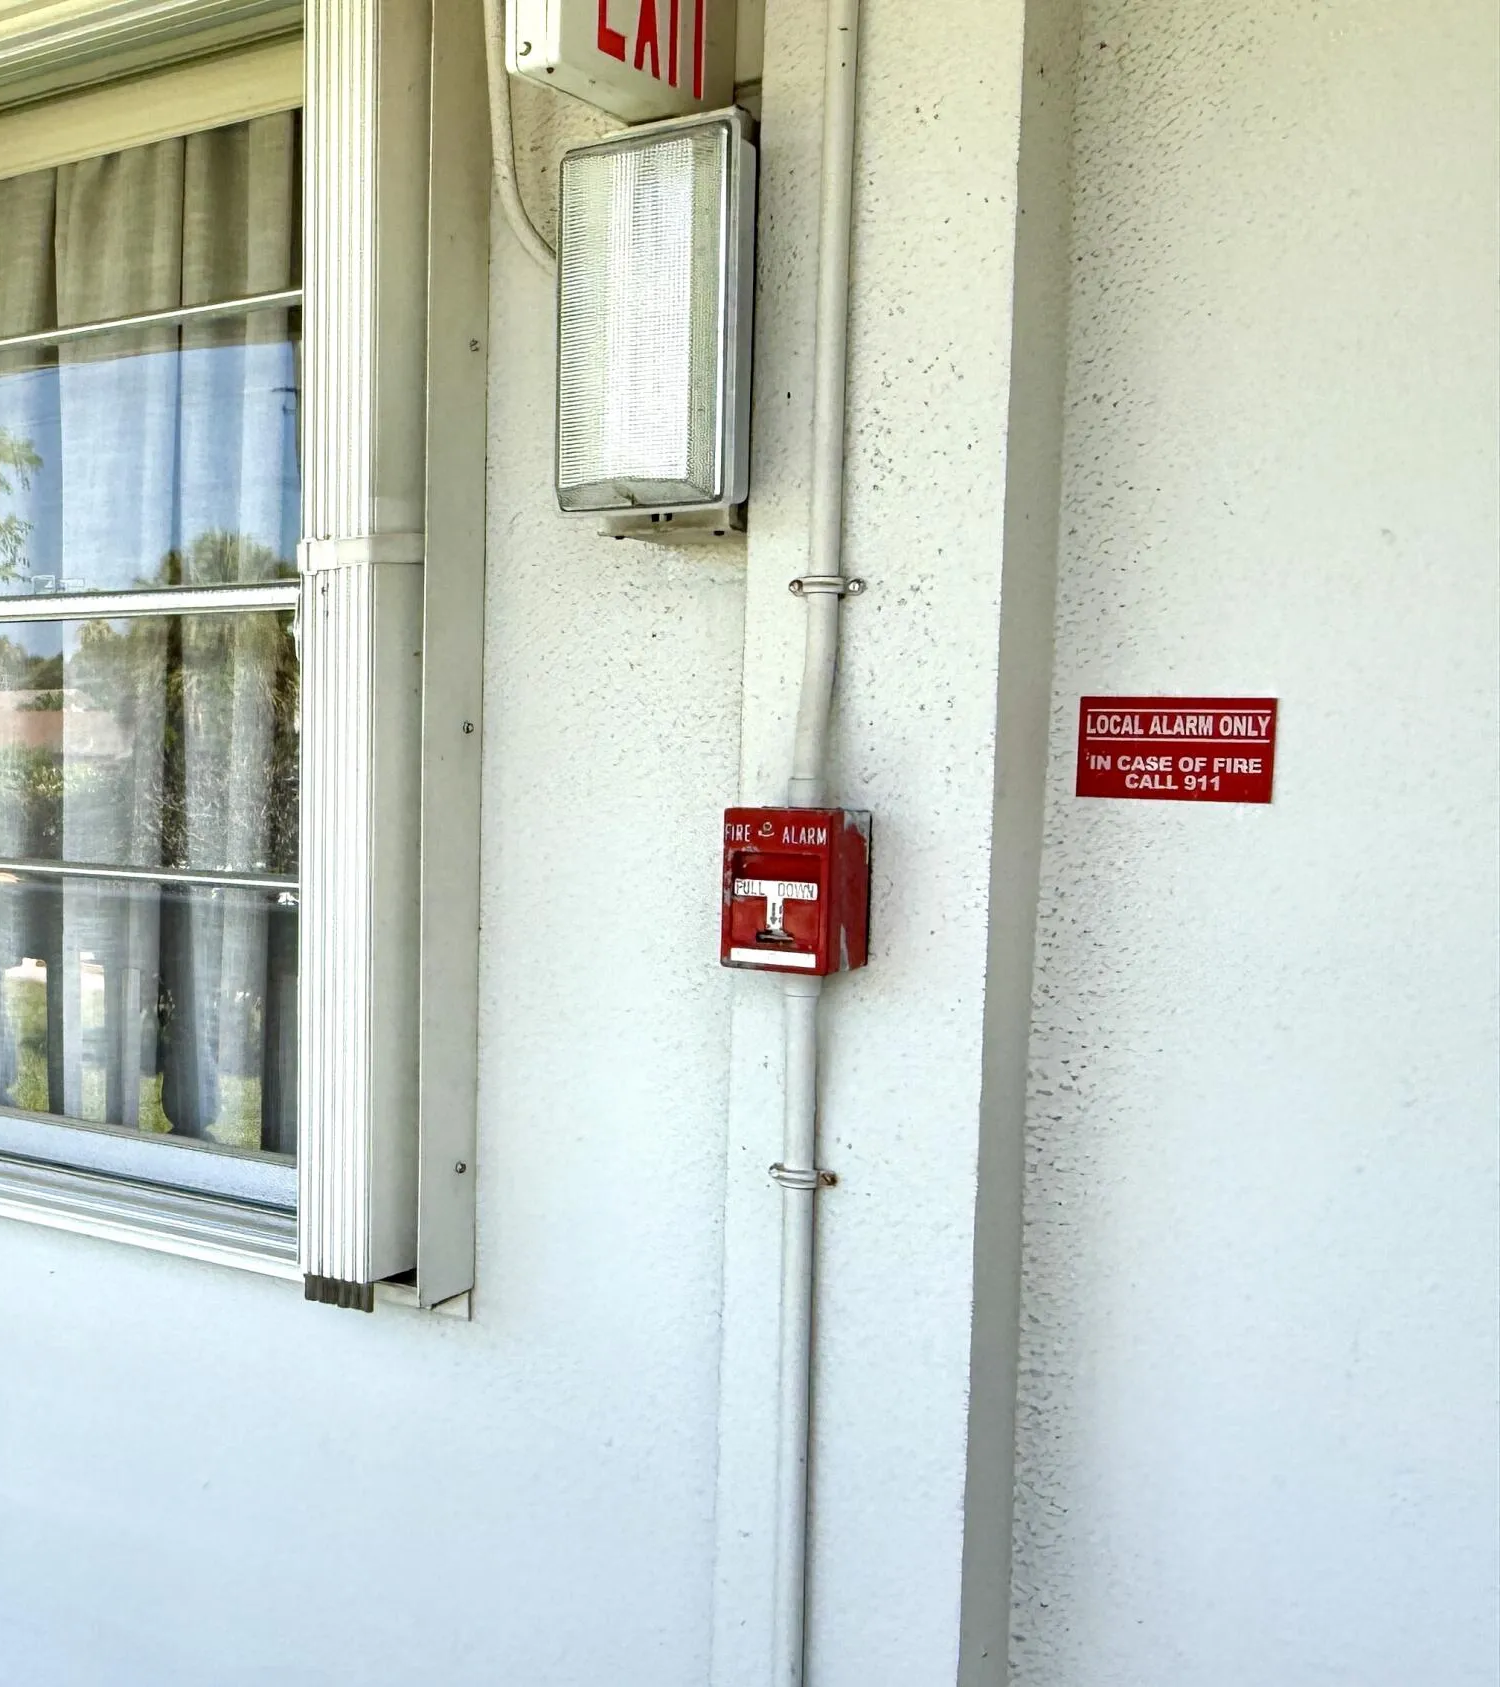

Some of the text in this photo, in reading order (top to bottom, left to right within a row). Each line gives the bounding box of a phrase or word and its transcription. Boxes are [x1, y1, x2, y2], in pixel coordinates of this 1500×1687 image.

[1086, 714, 1270, 737] LOCAL ALARM ONLY
[1090, 755, 1262, 774] IN CASE OF FIRE
[1125, 773, 1220, 791] CALL 911
[725, 824, 827, 846] FIRE ALARM
[736, 880, 814, 898] PULL DOWN
